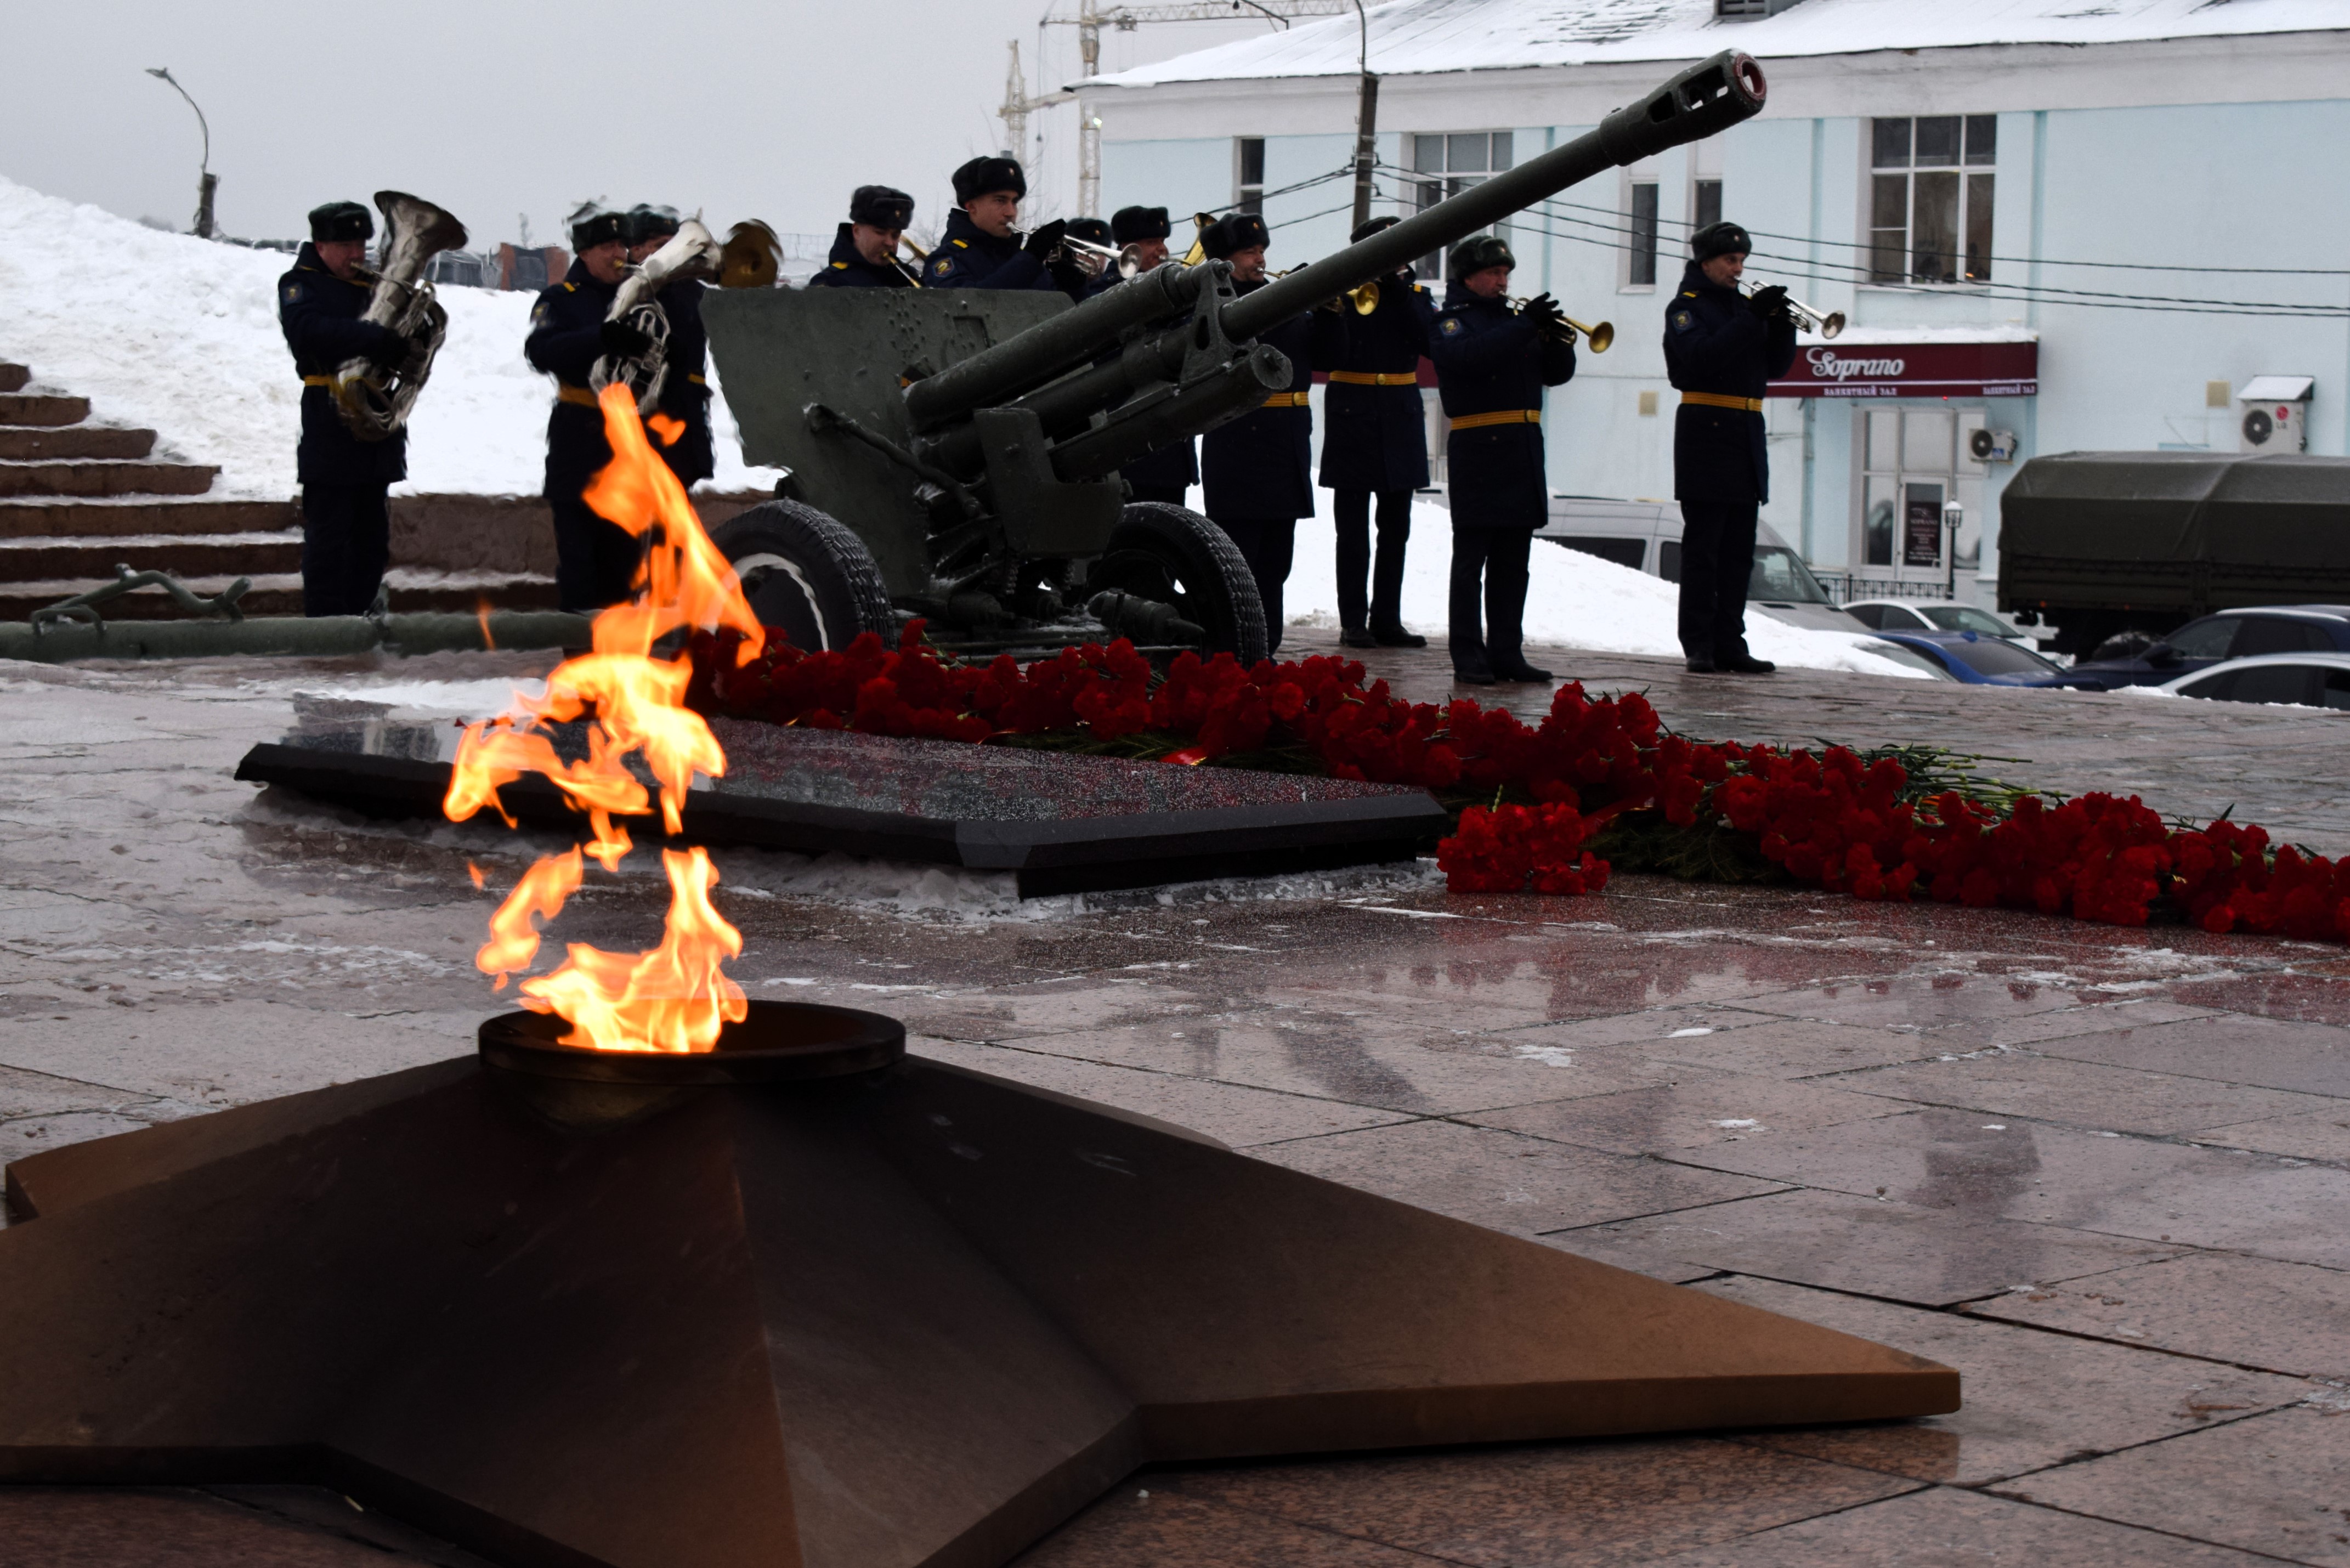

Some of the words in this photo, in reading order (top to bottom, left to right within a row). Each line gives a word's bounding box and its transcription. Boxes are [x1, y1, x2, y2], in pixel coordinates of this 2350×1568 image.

[1806, 347, 1905, 382] Soprano
[1824, 386, 1877, 395] БАНКЕТНЫЙ
[1879, 387, 1898, 395] ЗАЛ
